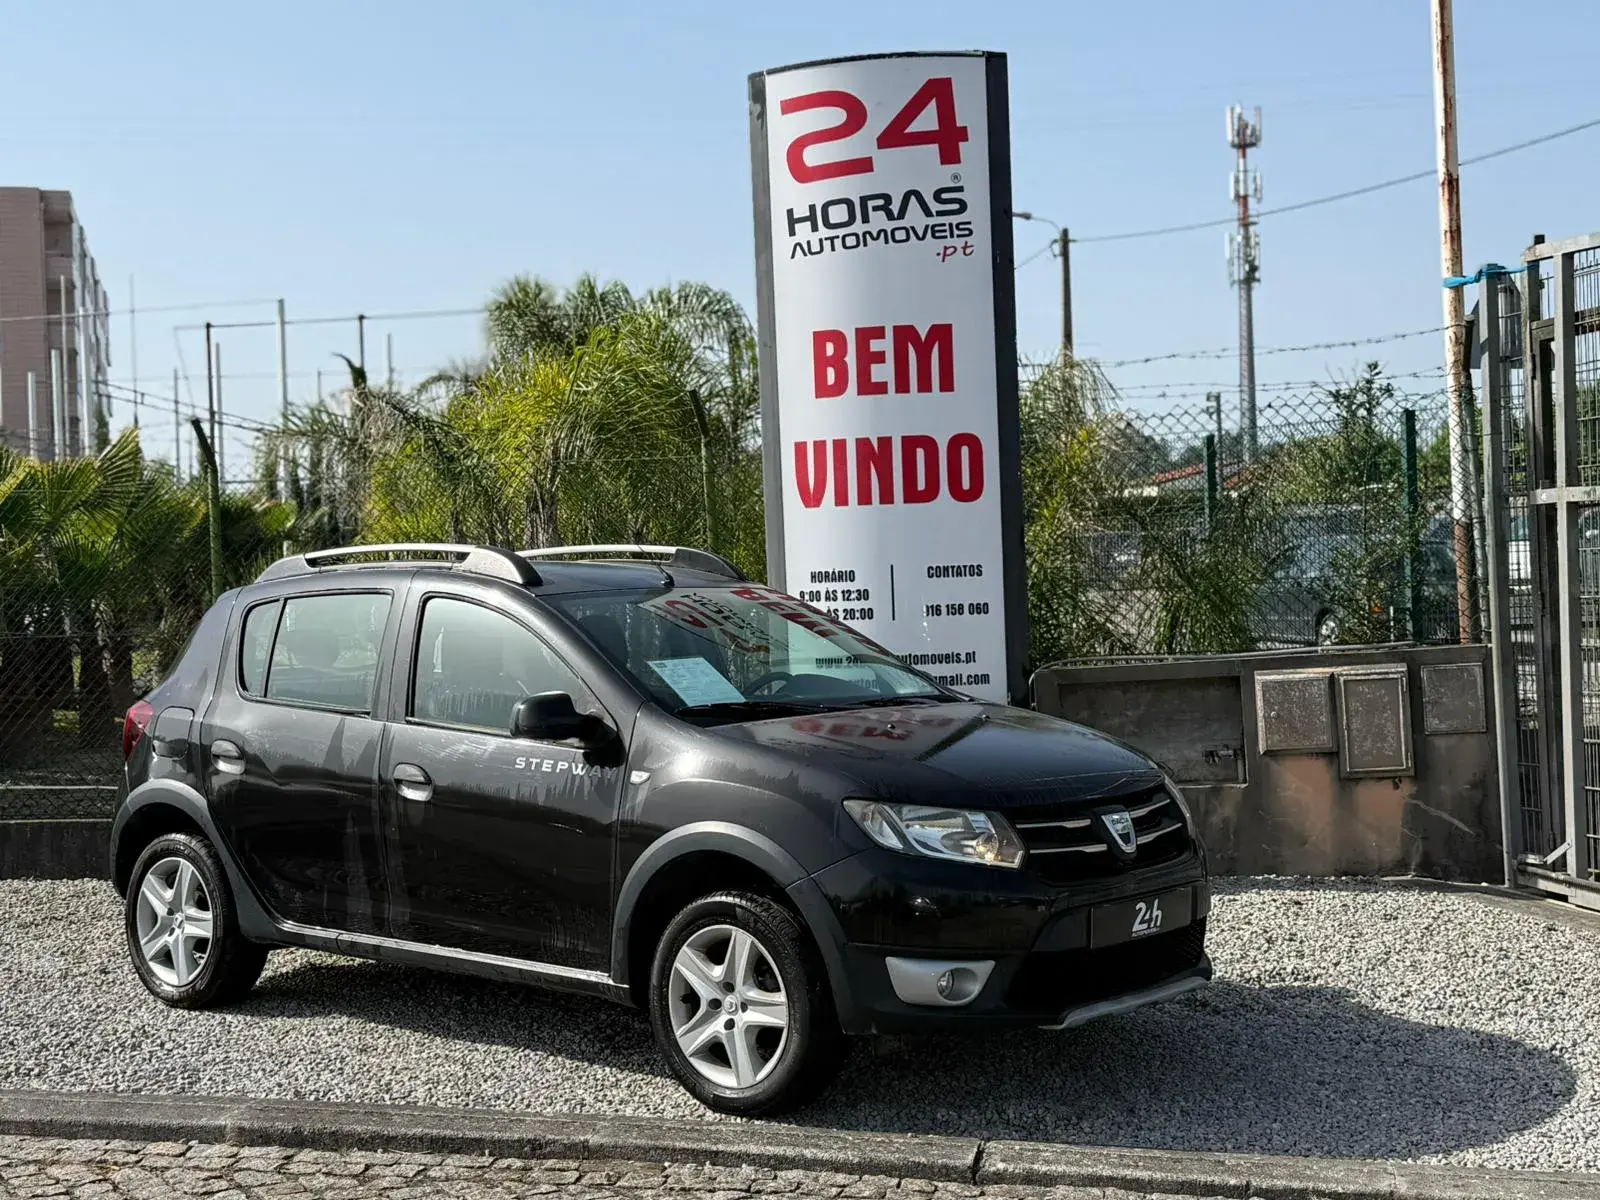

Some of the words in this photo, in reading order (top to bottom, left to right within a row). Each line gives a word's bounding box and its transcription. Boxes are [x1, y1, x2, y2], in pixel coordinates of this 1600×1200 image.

[780, 77, 969, 184] 24
[786, 185, 968, 237] HORAS
[790, 221, 974, 260] AUTOMOVEIS
[936, 241, 974, 263] .pt
[812, 323, 955, 399] BEM
[794, 432, 985, 509] VINDO
[810, 568, 856, 583] HORÁRIO
[927, 564, 983, 579] CONTATOS
[841, 588, 870, 601] 12:30
[842, 607, 874, 620] 20:00
[945, 603, 965, 616] 158
[968, 602, 989, 616] 060
[514, 757, 617, 779] STEPWAY
